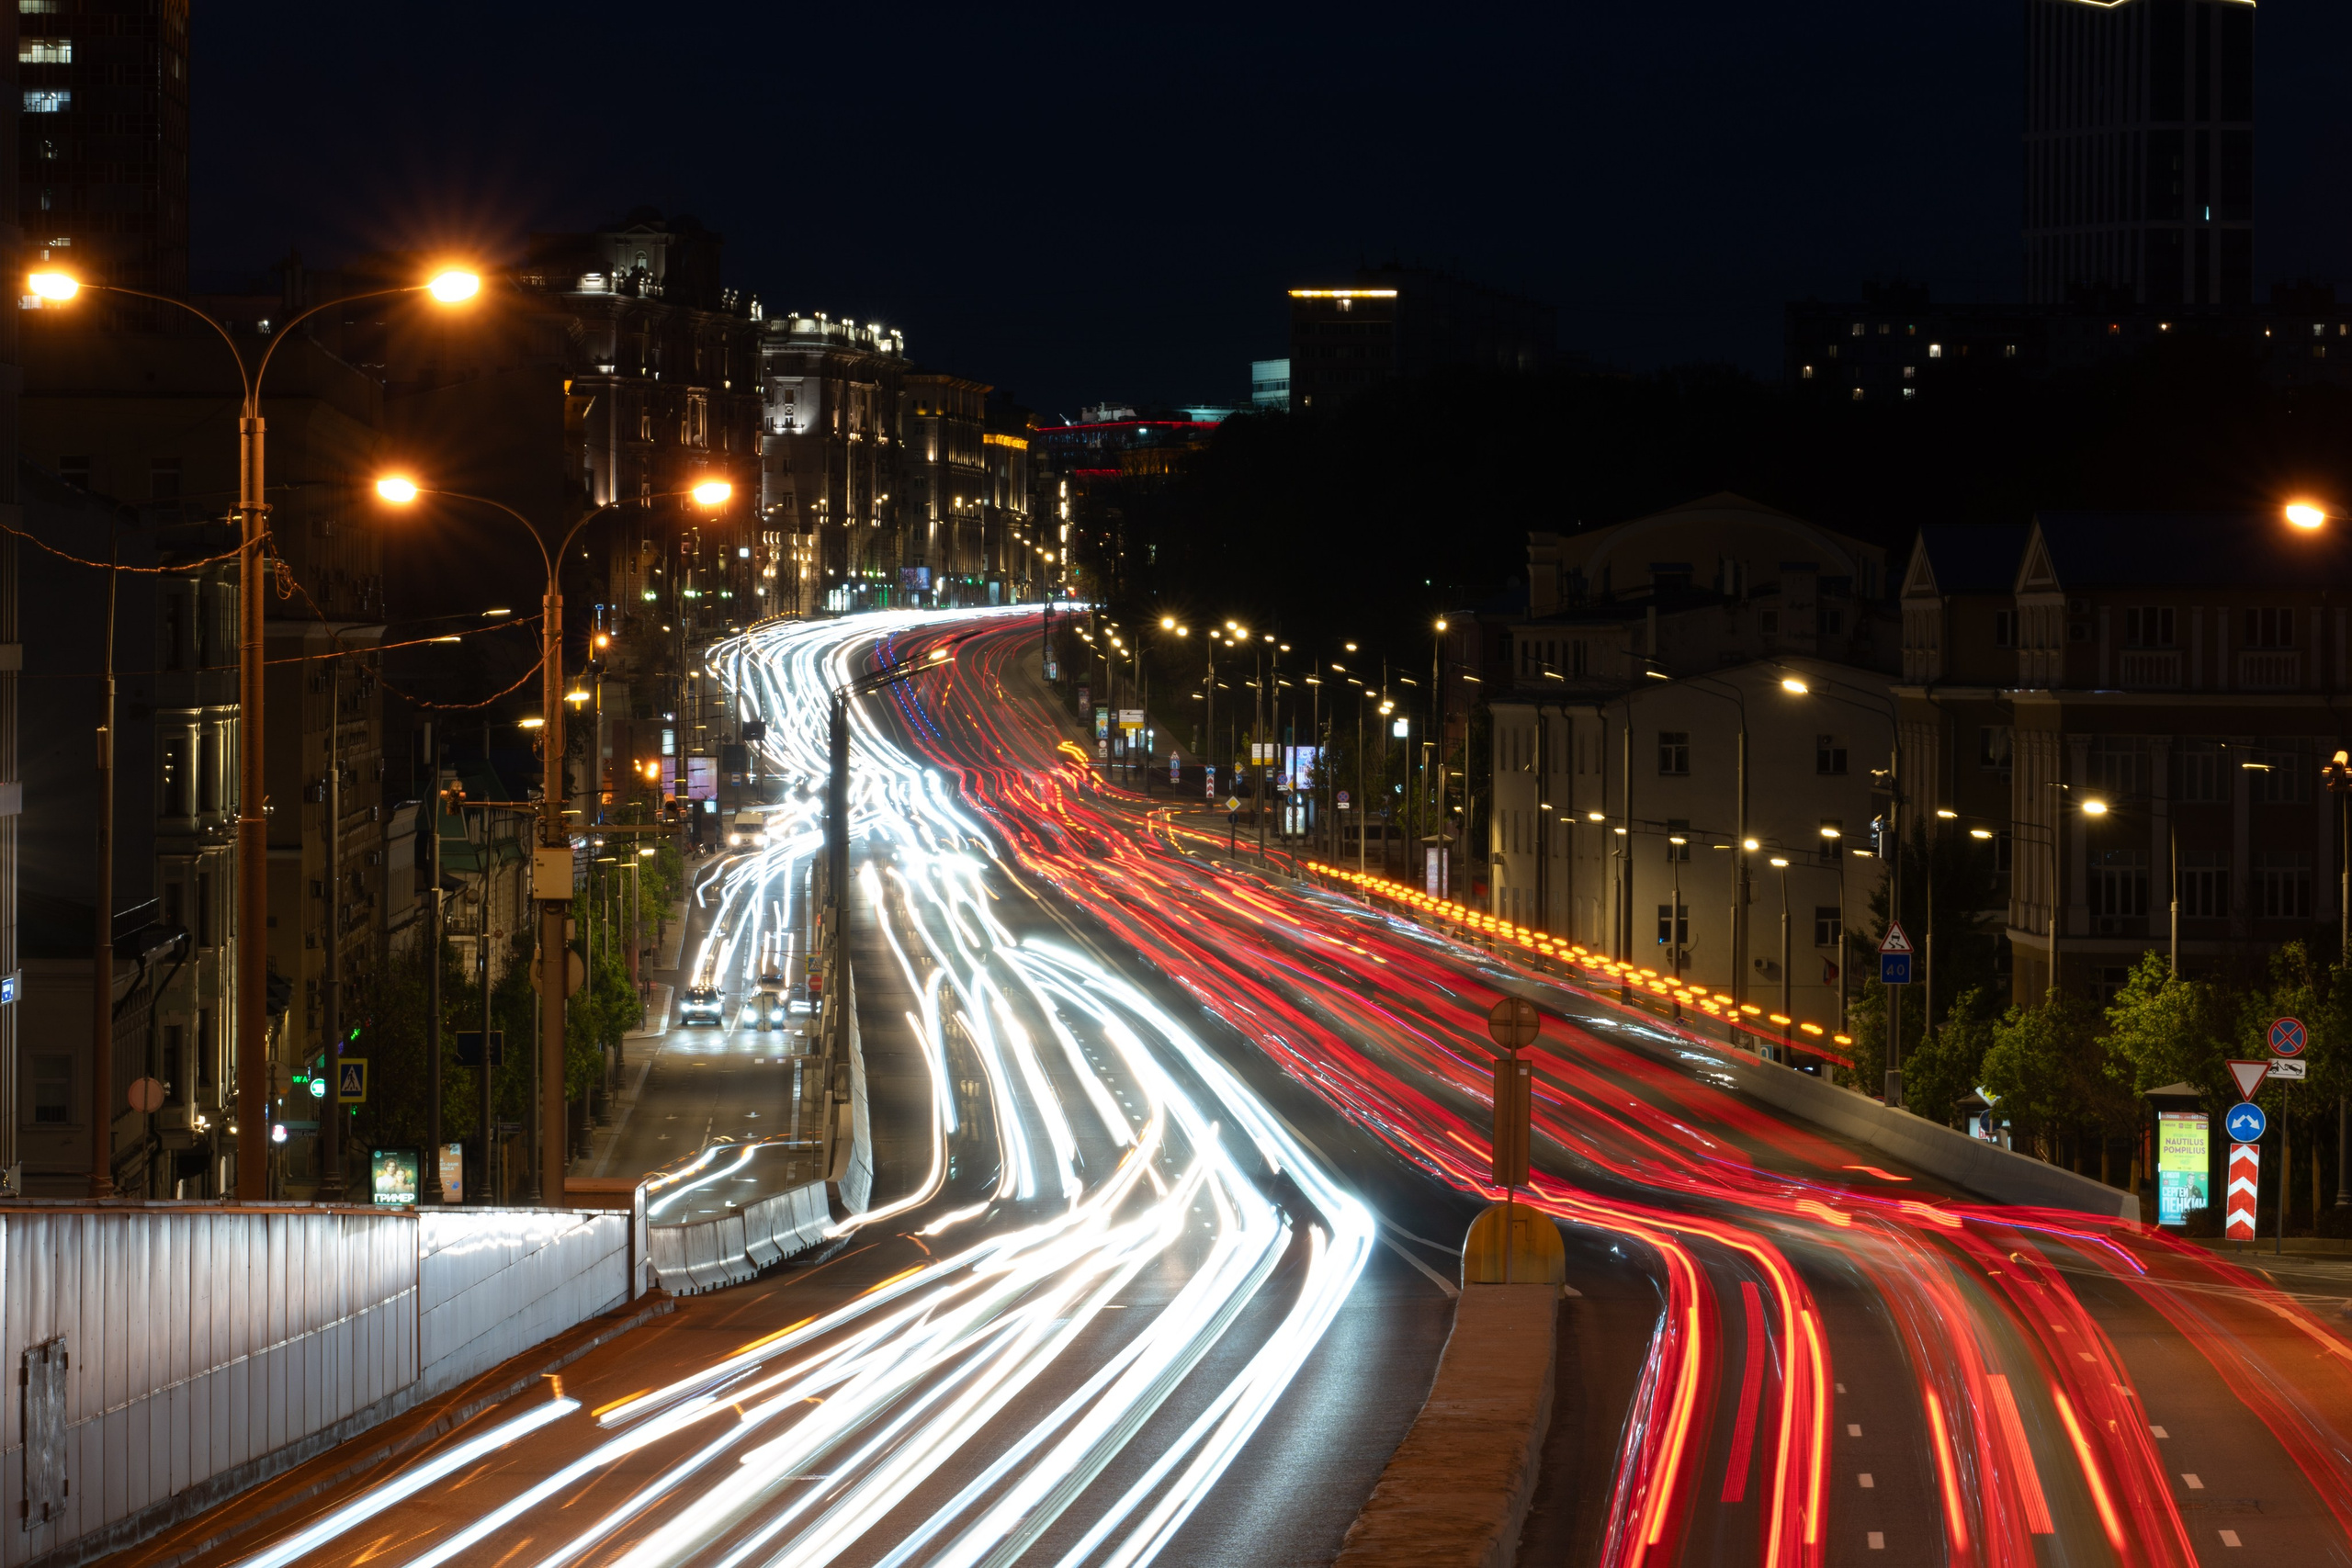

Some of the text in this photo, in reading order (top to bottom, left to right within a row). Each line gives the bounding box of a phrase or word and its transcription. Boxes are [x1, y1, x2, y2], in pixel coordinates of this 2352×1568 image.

[1886, 964, 1905, 976] 40
[2164, 1146, 2206, 1155] POMPILIUS
[374, 1193, 415, 1202] ГРИМЕР
[2162, 1185, 2188, 1198] СЕРГЕЙ
[2162, 1197, 2207, 1213] ПЕНКИН
